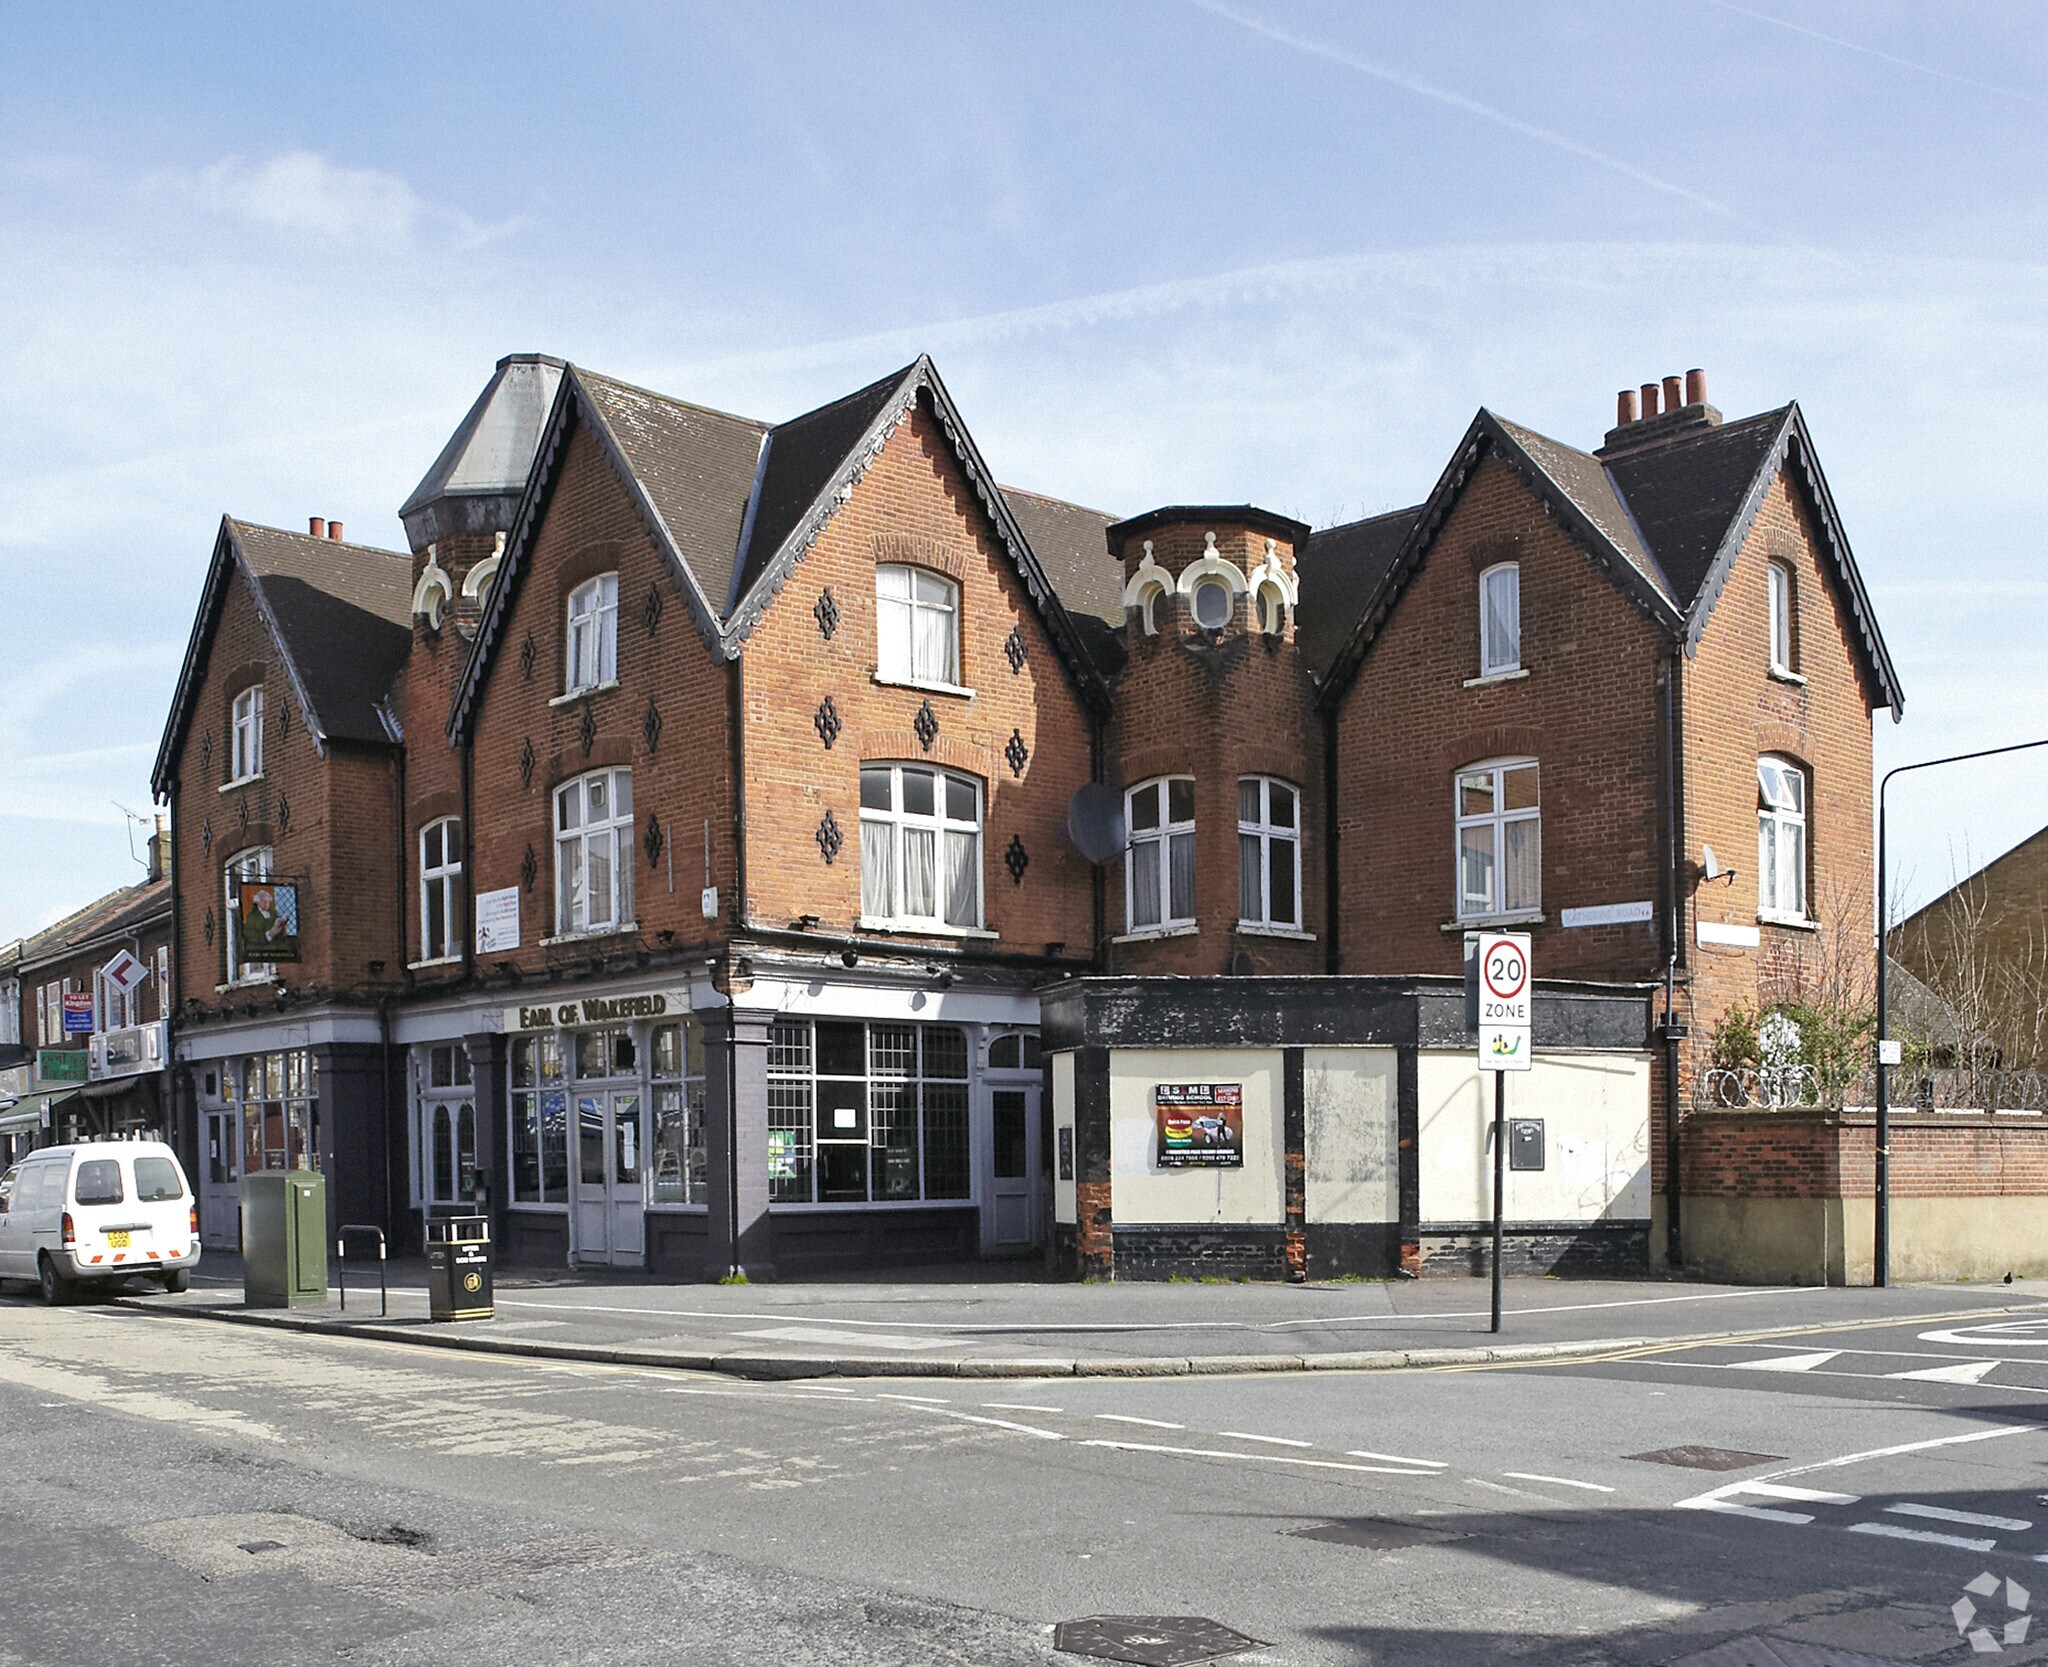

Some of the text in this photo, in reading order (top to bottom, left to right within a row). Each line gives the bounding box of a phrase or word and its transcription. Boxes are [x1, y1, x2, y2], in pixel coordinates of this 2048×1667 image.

[1565, 909, 1612, 924] KATHERINE
[1616, 907, 1641, 918] ROAD
[1492, 958, 1521, 981] 20
[519, 994, 666, 1028] EARL OF WAKEFIELD
[1486, 1003, 1525, 1018] ZONE
